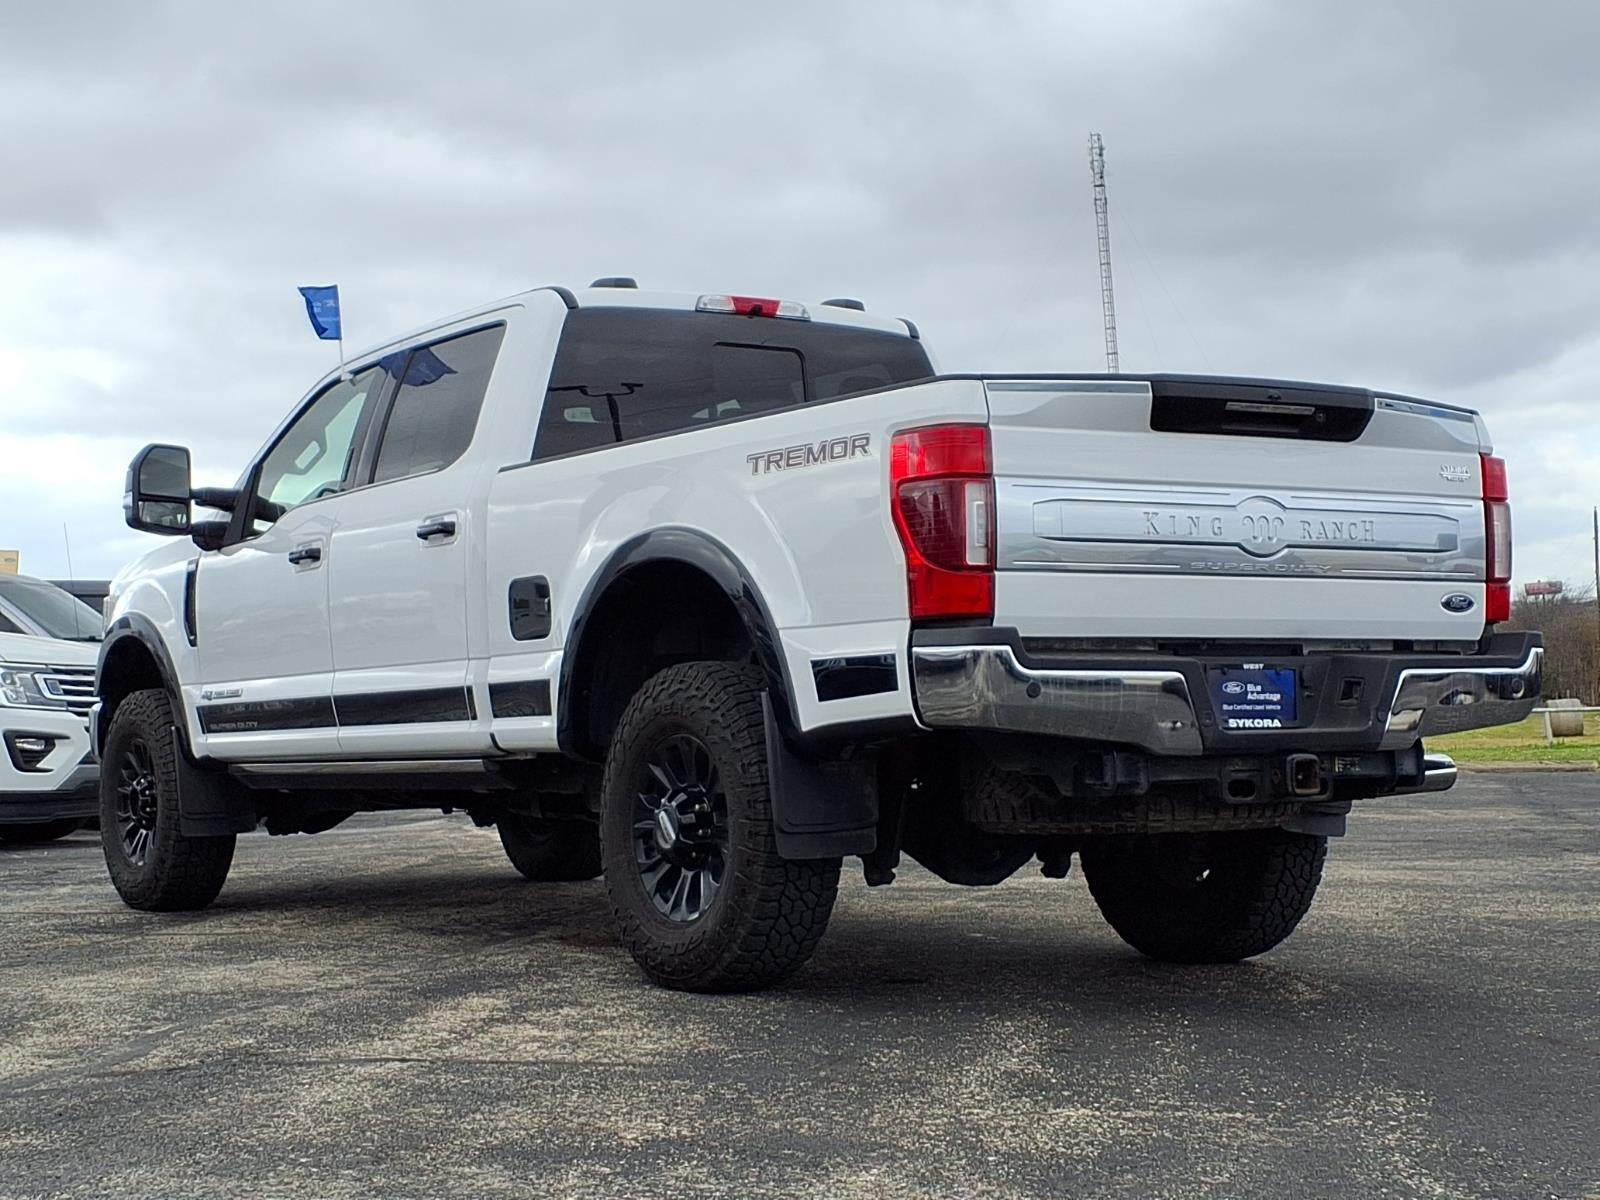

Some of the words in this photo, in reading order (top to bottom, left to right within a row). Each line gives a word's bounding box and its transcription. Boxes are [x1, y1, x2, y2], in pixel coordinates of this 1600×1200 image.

[746, 432, 872, 476] TREMOR
[1142, 510, 1224, 537] KING
[1300, 519, 1376, 543] RANCH
[1190, 561, 1269, 572] SUPER
[1246, 683, 1262, 692] Blue
[1227, 718, 1282, 728] SYKORA
